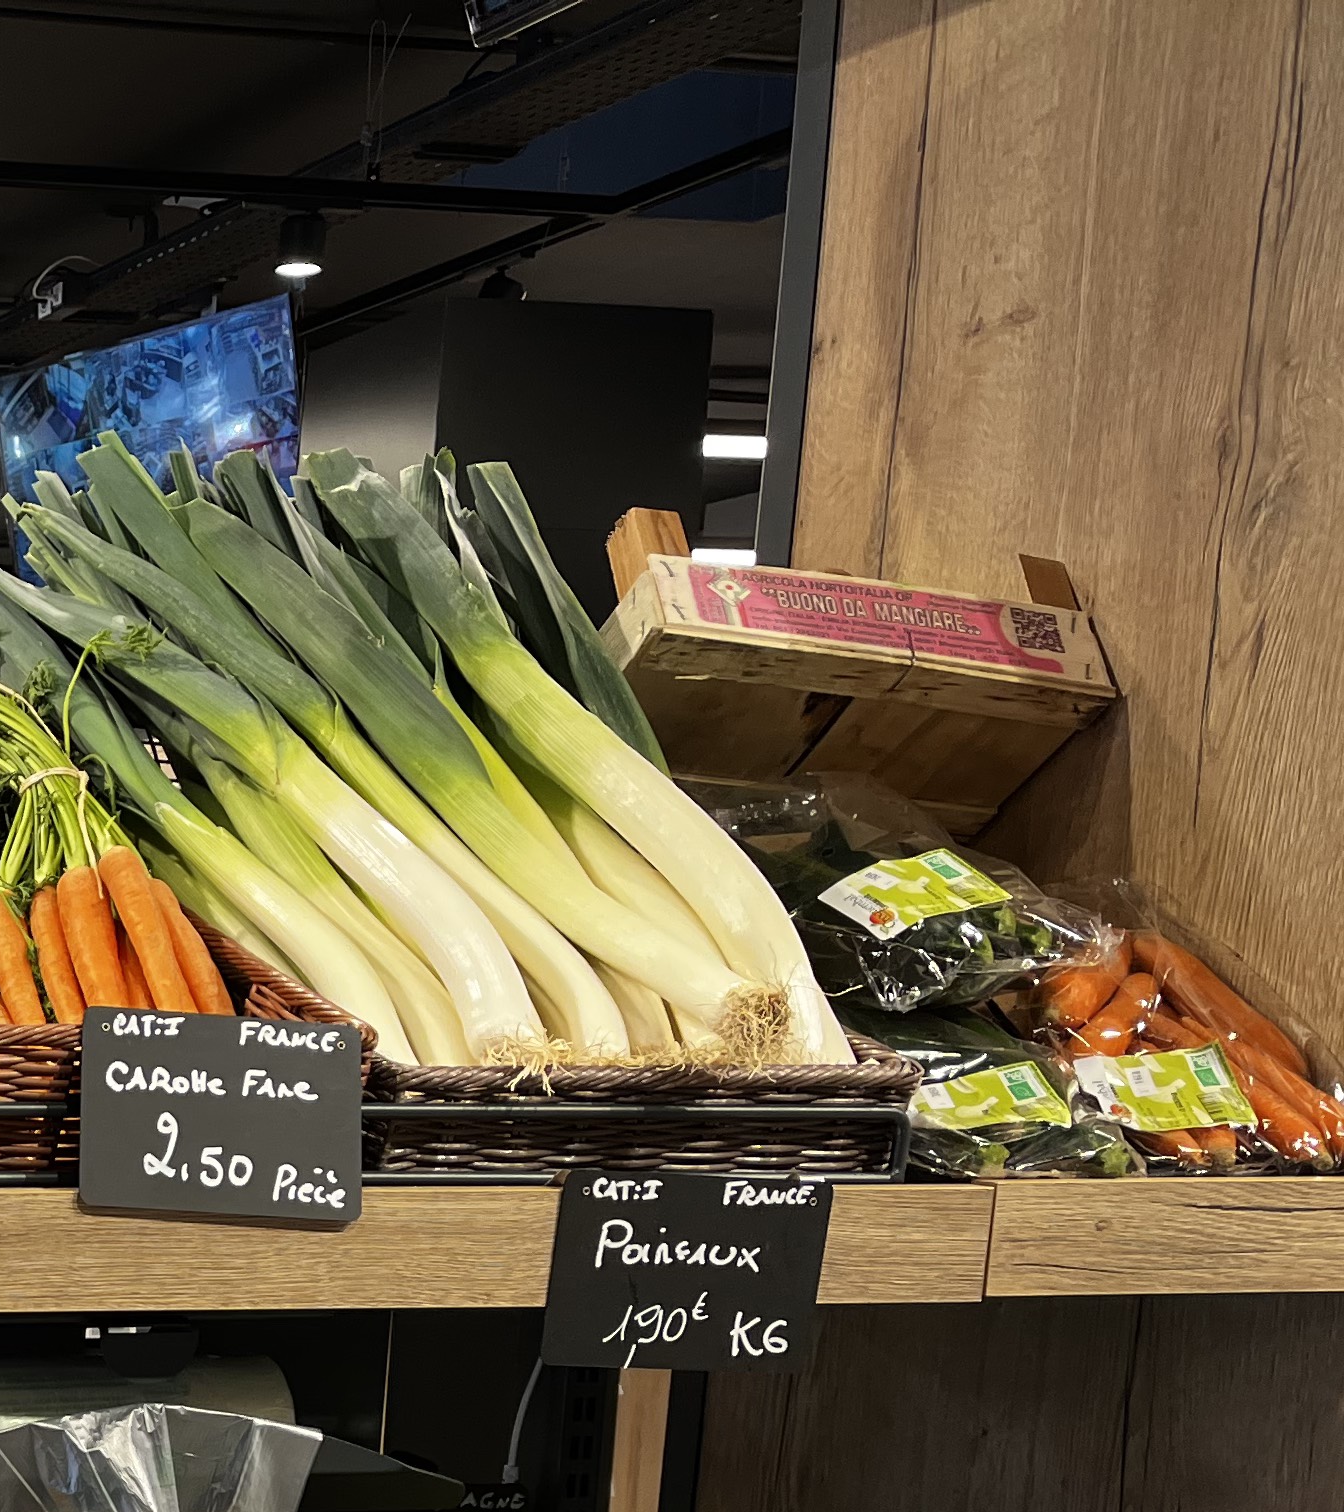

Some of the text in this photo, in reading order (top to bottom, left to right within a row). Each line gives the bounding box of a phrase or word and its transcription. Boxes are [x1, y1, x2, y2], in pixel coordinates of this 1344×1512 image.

[741, 573, 807, 590] AGRICOLA
[842, 597, 868, 619] DA
[239, 1021, 340, 1052] FRANCE
[144, 1112, 253, 1186] 2,50
[722, 1180, 814, 1207] FRANCE
[730, 1312, 787, 1356] KG
[459, 1492, 527, 1510] AGNE
